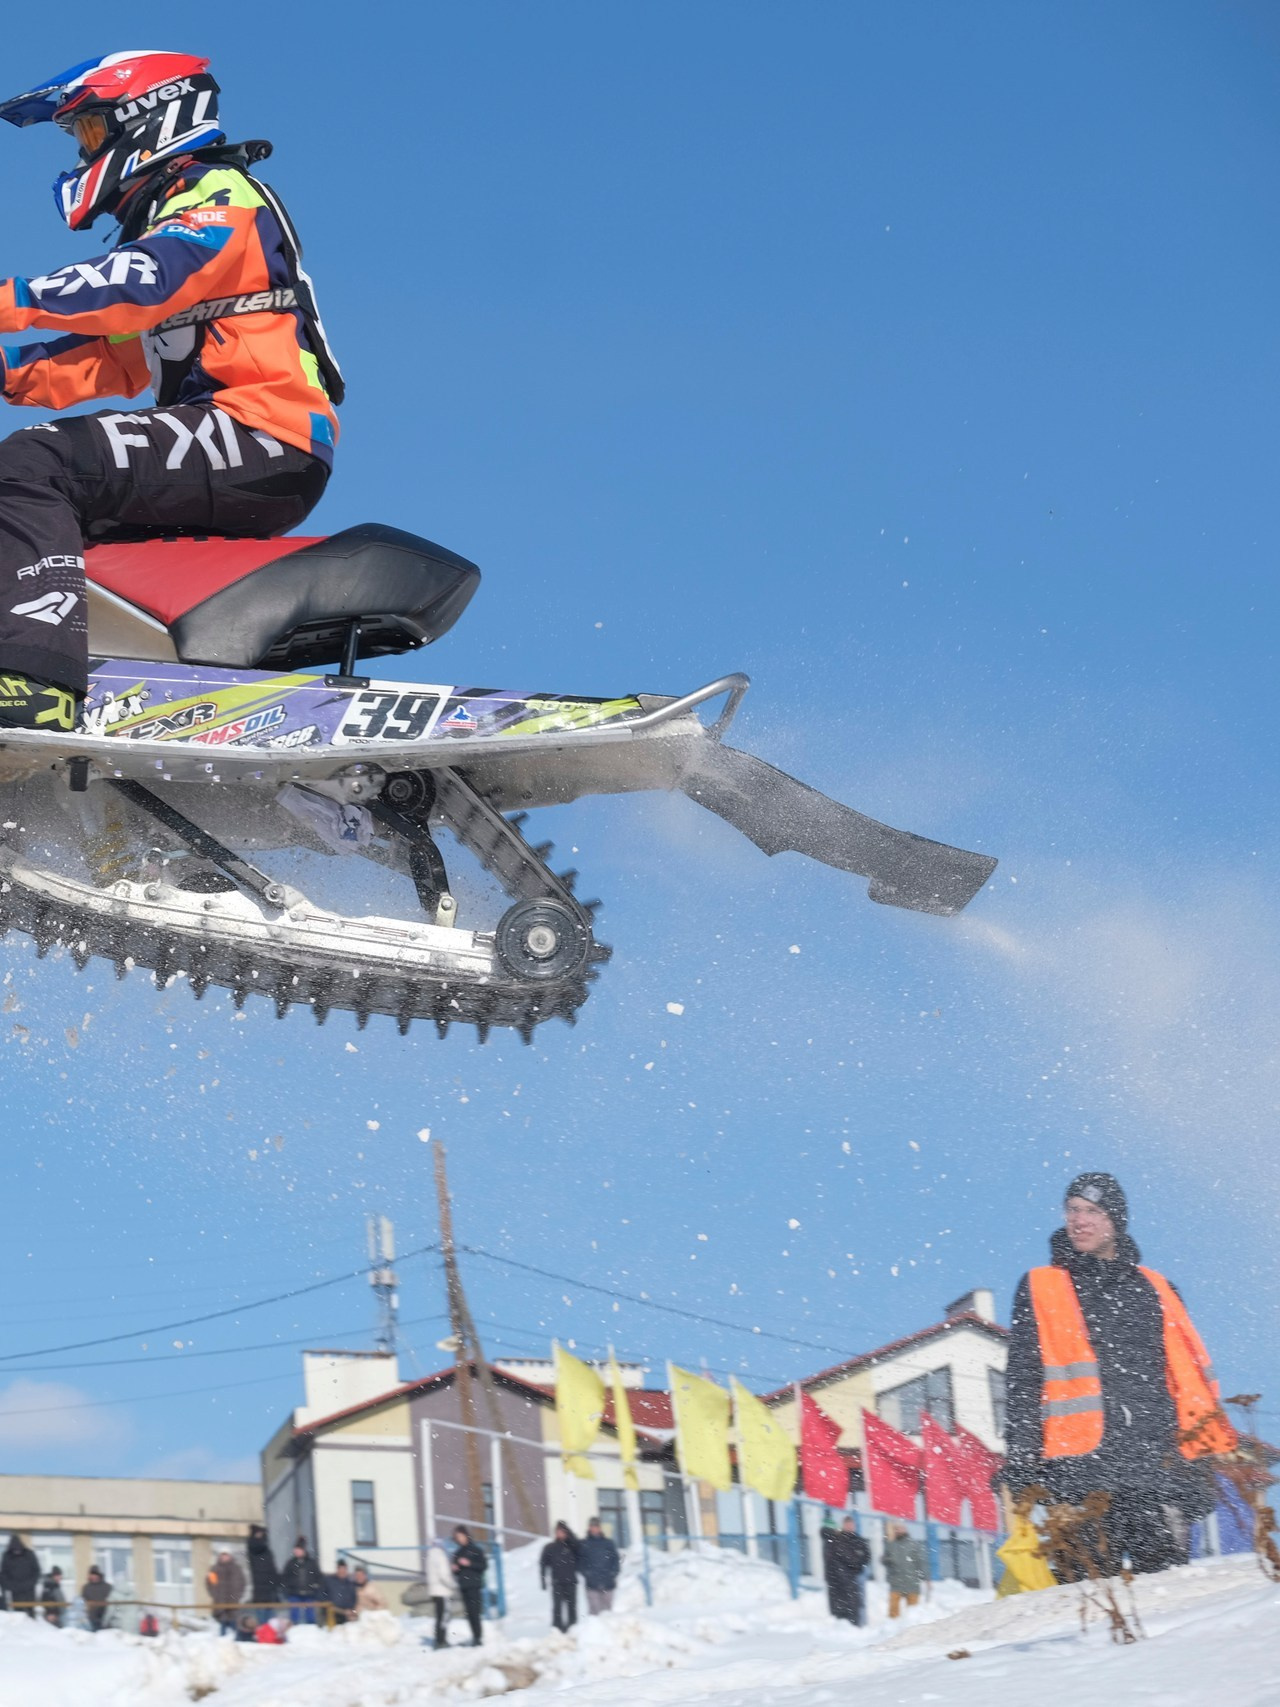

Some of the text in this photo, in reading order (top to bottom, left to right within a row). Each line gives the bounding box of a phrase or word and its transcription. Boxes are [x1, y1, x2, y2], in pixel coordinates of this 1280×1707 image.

[114, 78, 197, 123] uvex
[28, 251, 159, 300] FXR
[16, 555, 77, 581] RACE
[123, 702, 217, 740] FXR
[191, 705, 285, 744] AMSOIL
[342, 692, 441, 739] 39
